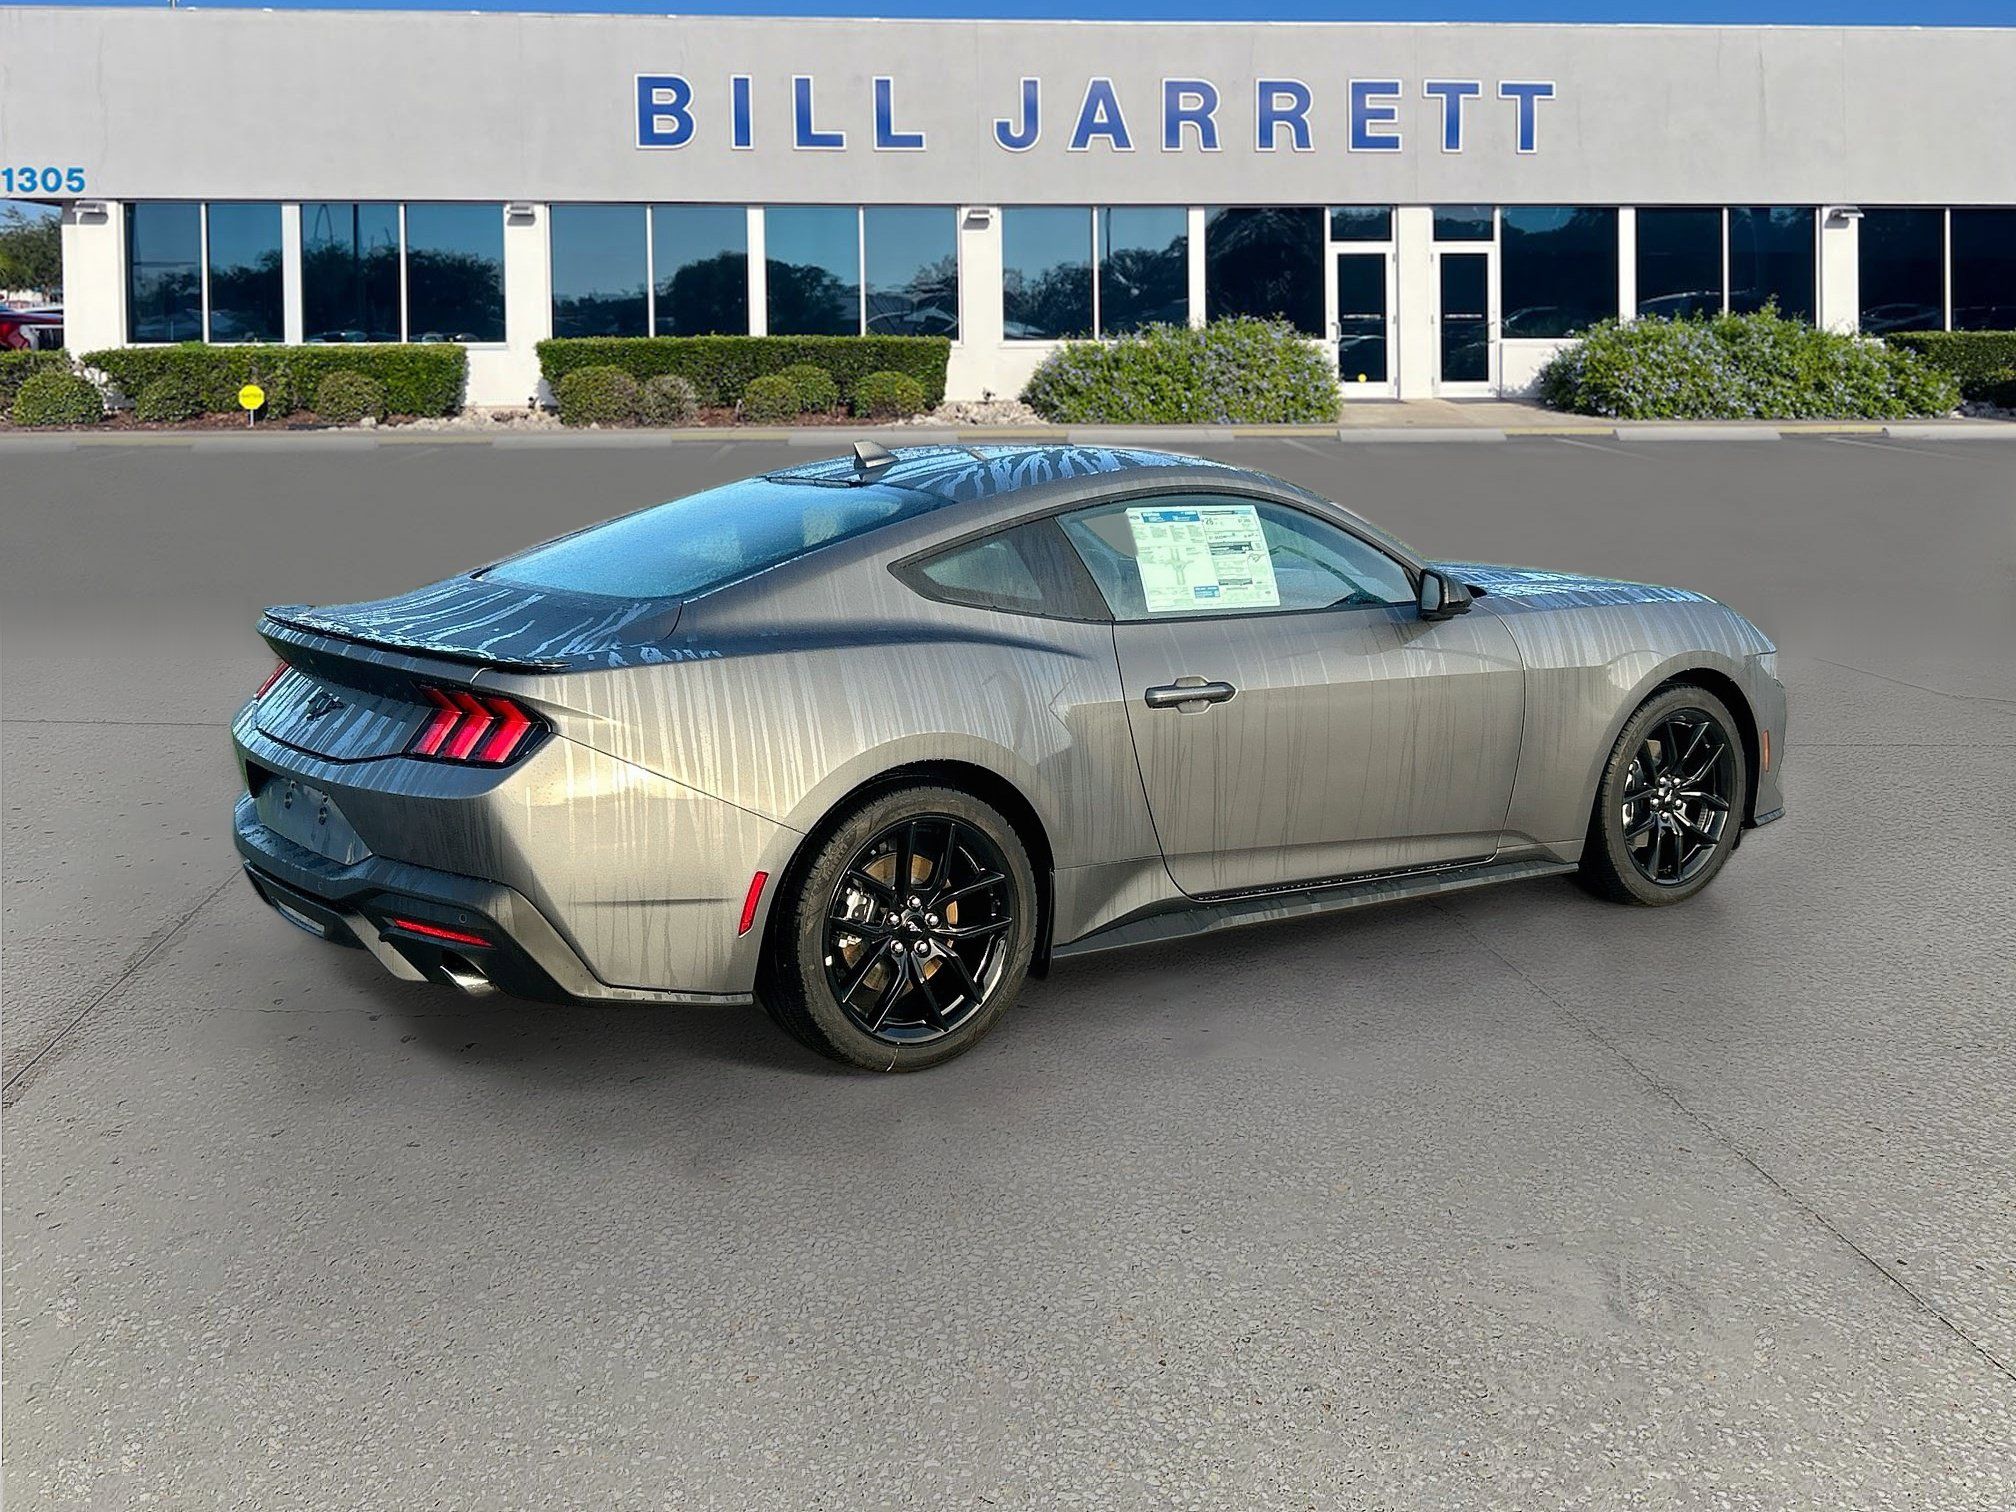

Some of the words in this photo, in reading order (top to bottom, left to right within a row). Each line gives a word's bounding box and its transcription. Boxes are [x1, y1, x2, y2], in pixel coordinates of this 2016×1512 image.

[635, 74, 926, 151] BILL
[993, 77, 1556, 153] JARRETT
[1, 166, 86, 193] 1305
